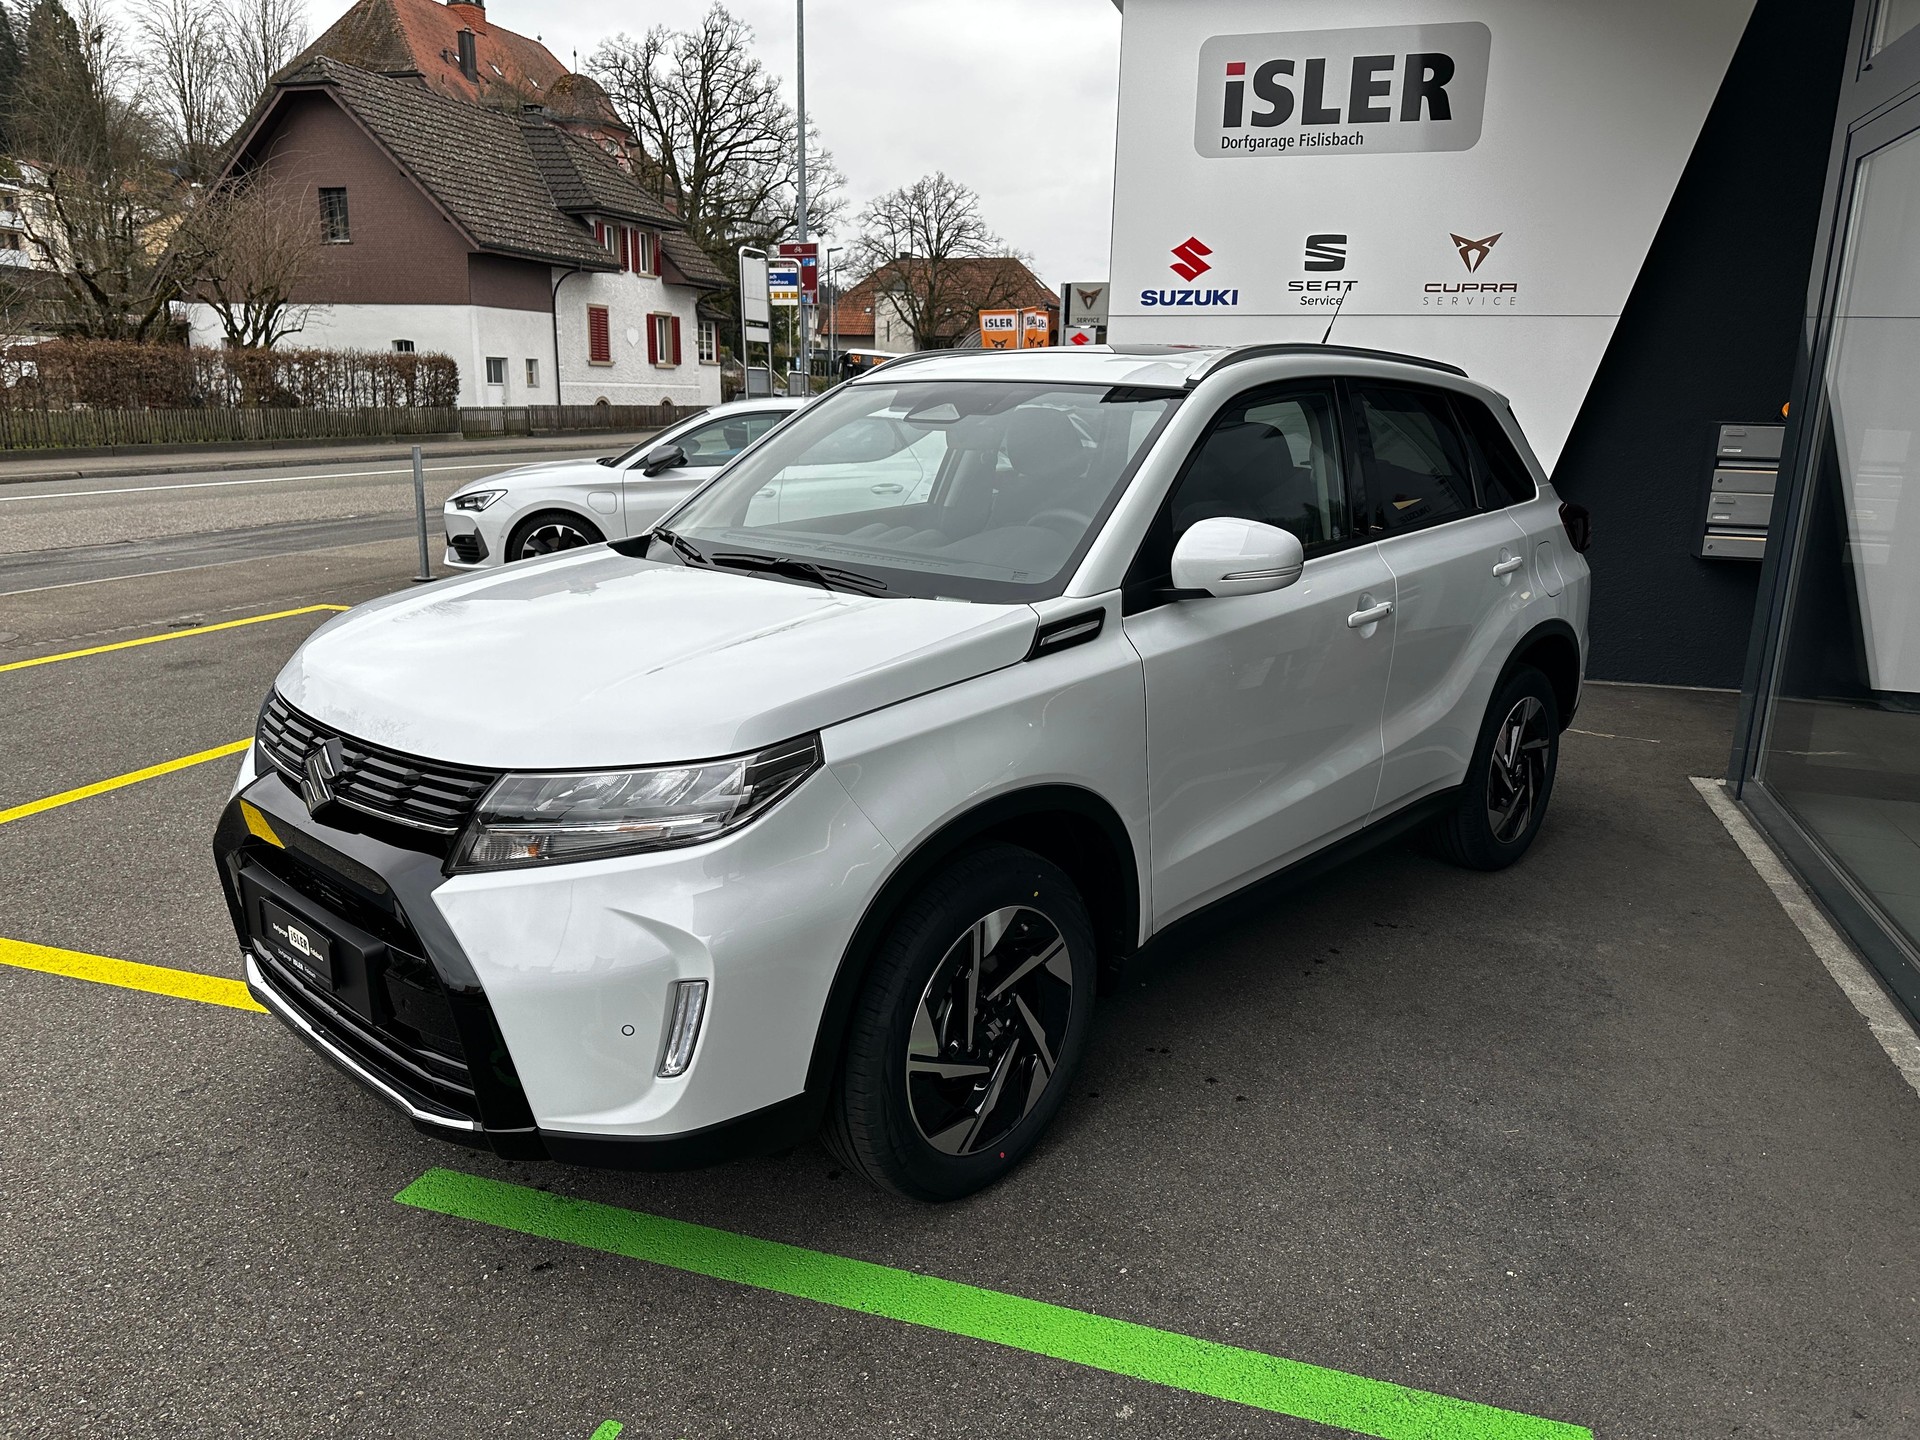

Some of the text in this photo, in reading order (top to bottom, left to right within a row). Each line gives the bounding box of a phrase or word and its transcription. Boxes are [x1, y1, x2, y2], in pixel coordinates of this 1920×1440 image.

[1221, 131, 1364, 152] Dorfgarage Fislisbach
[1288, 280, 1358, 292] SEAT
[1424, 283, 1518, 293] CUPRA
[1140, 289, 1239, 306] SUZUKI
[1300, 295, 1344, 306] Service
[1422, 296, 1517, 306] SERVICE
